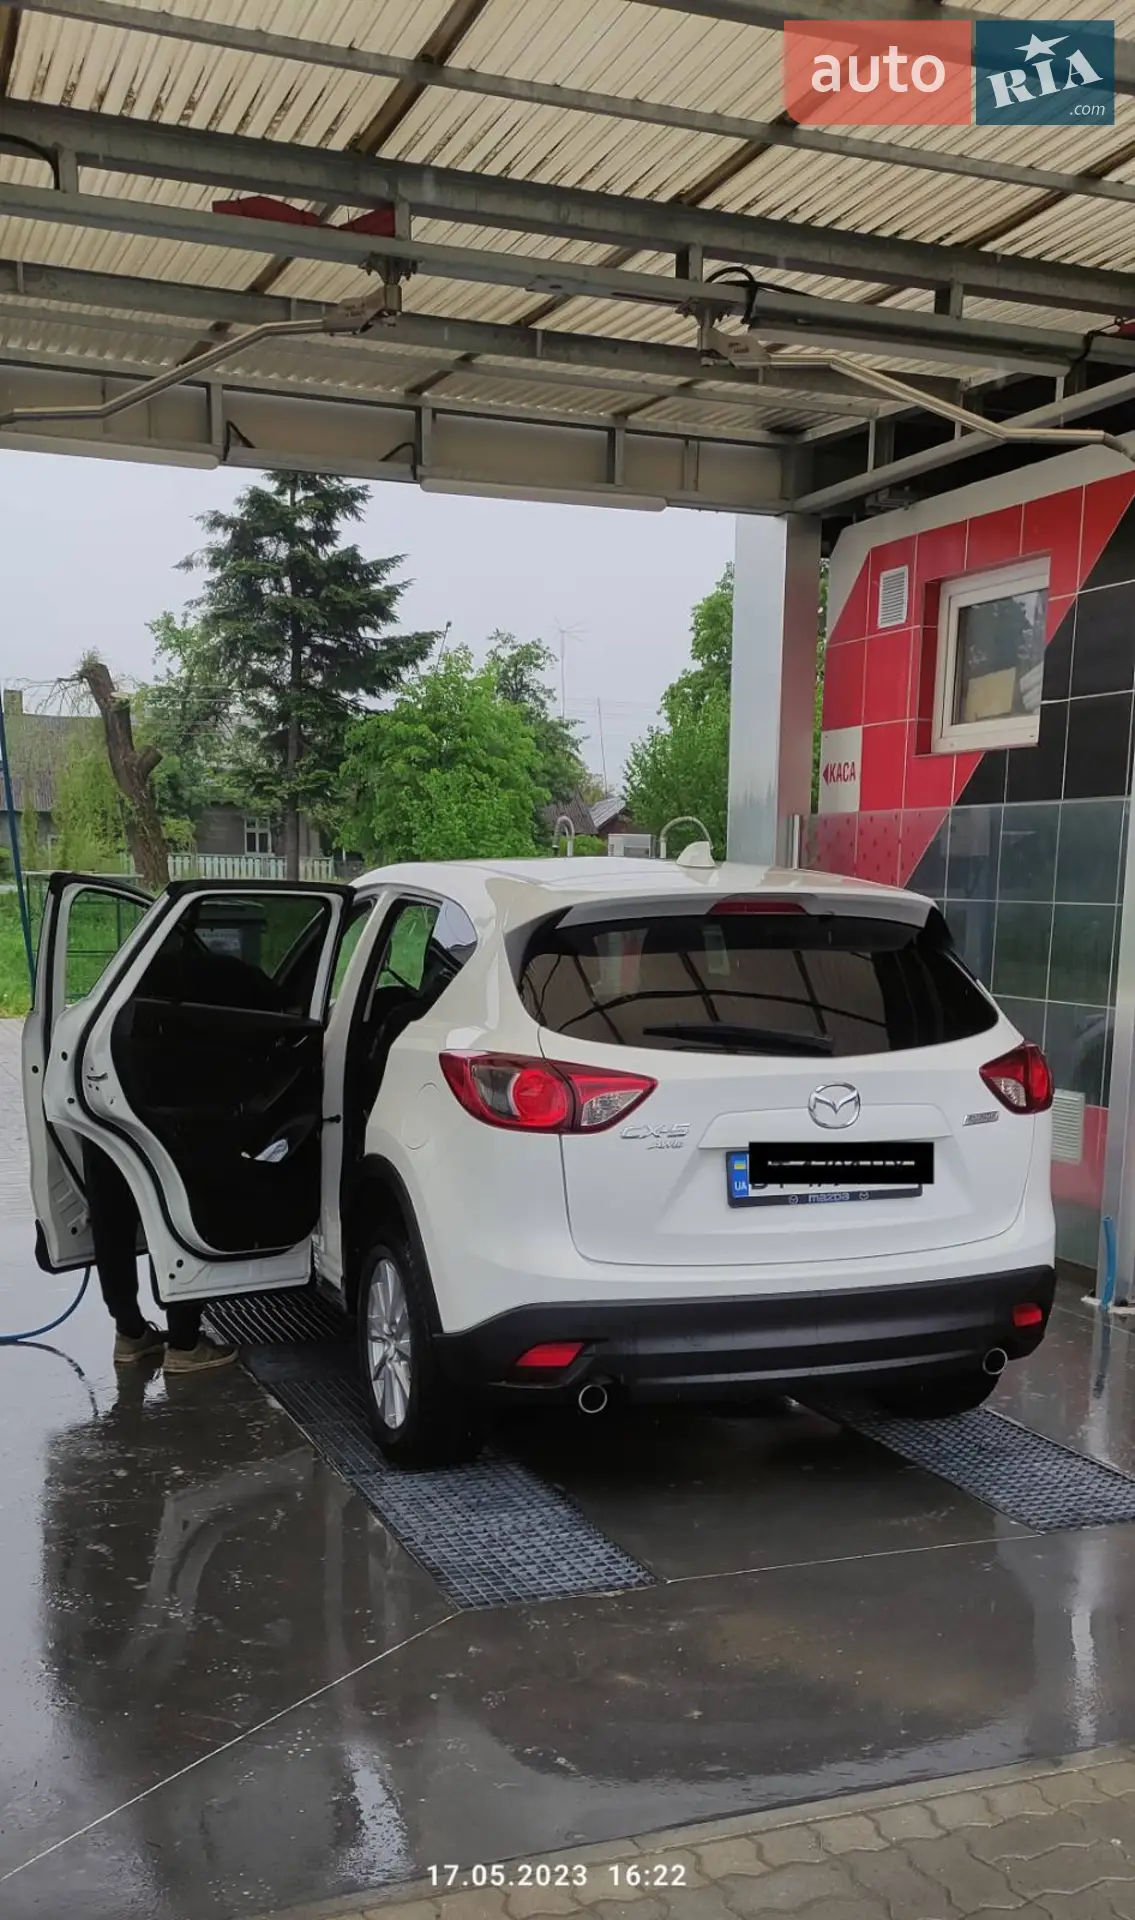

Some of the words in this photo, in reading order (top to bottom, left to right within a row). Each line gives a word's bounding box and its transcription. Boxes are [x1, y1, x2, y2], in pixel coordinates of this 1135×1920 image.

[829, 762, 857, 783] КАСА
[620, 1122, 691, 1139] CX-5
[734, 1181, 748, 1191] UA
